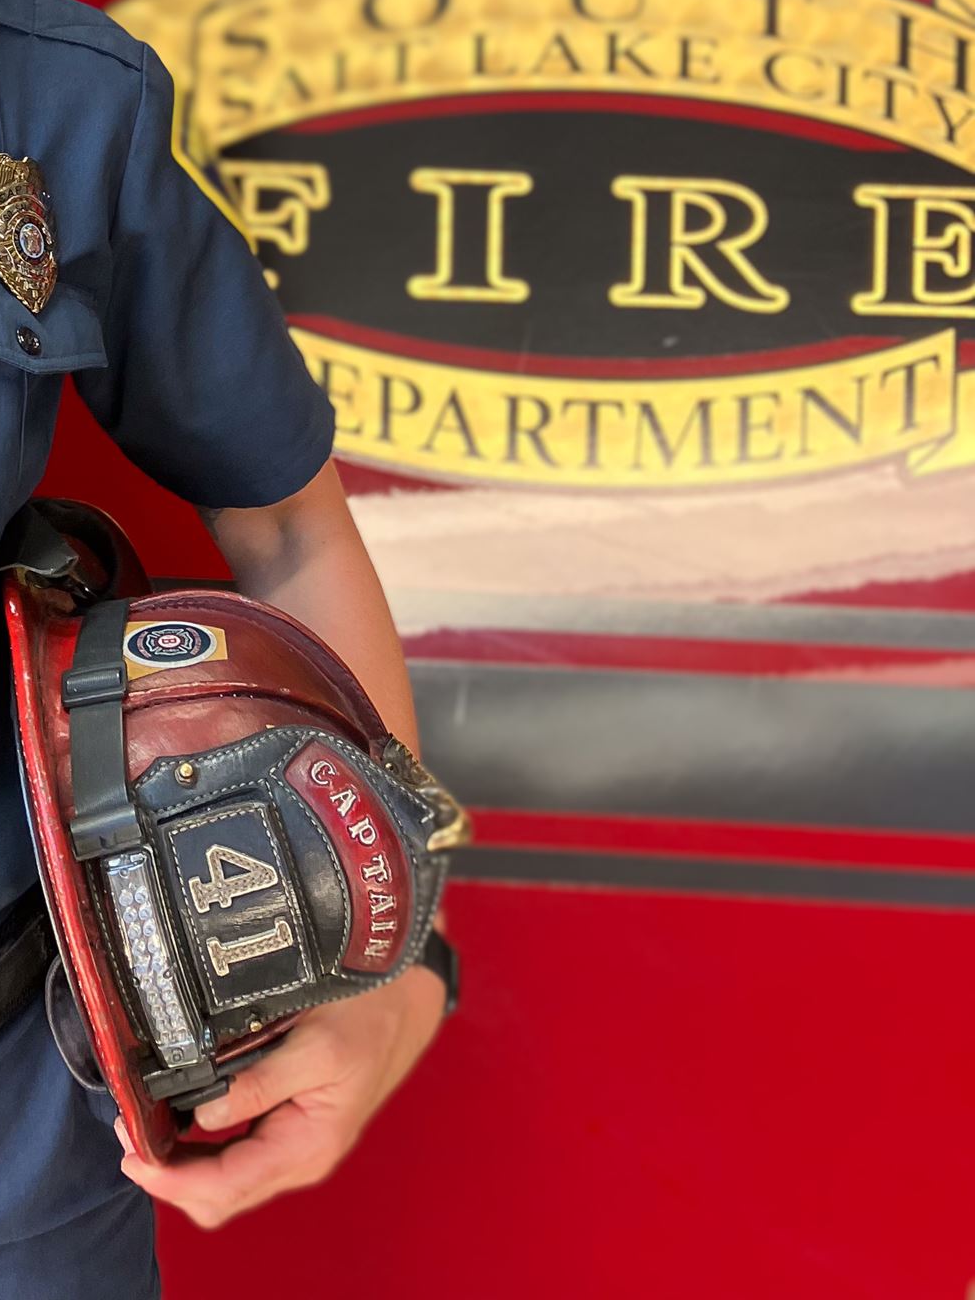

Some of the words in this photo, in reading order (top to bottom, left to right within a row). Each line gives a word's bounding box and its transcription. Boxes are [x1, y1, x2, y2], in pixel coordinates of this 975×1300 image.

[221, 38, 427, 123] SALT
[472, 31, 722, 85] LAKE
[763, 48, 975, 145] CITY
[220, 161, 975, 317] FIRE
[316, 353, 941, 472] EPARTMENT
[187, 843, 294, 978] 41
[308, 760, 398, 960] CAPTAIN
